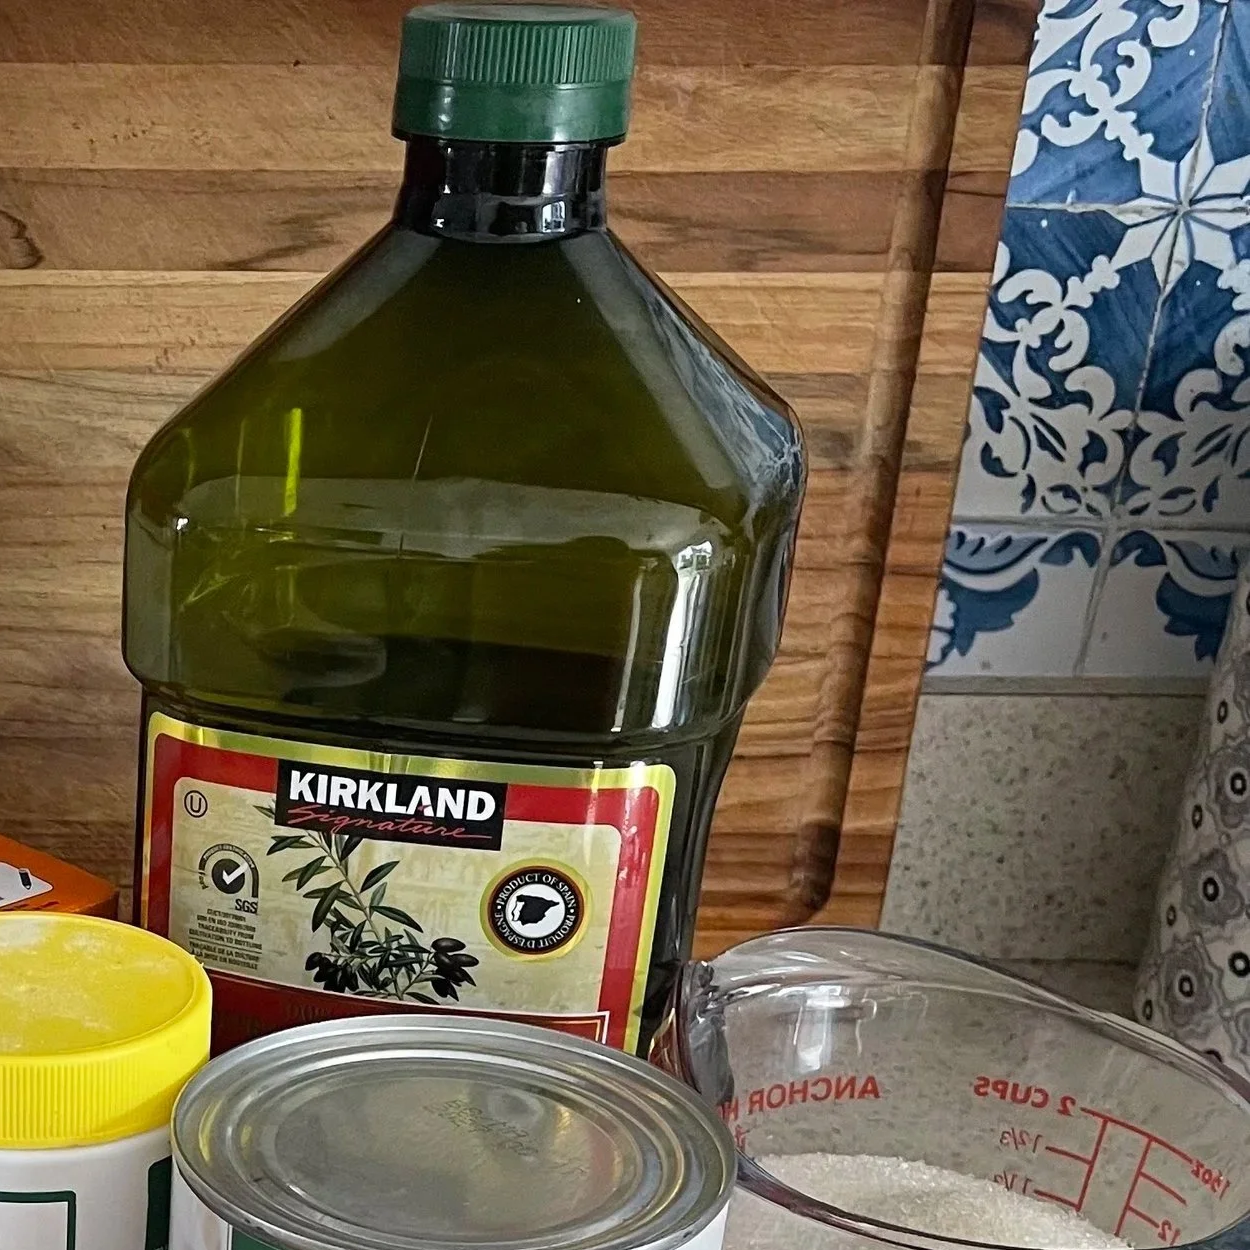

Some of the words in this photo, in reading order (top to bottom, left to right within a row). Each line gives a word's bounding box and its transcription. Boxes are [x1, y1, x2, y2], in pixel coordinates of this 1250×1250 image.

[289, 770, 496, 821] KIRKLAND
[288, 804, 492, 839] Signature
[235, 899, 258, 915] SGS
[496, 873, 540, 905] PRODUCT
[542, 873, 558, 884] OF
[556, 881, 577, 908] SPAIN
[494, 911, 535, 949] D'ESPAGNE
[536, 915, 576, 949] PRODUIT
